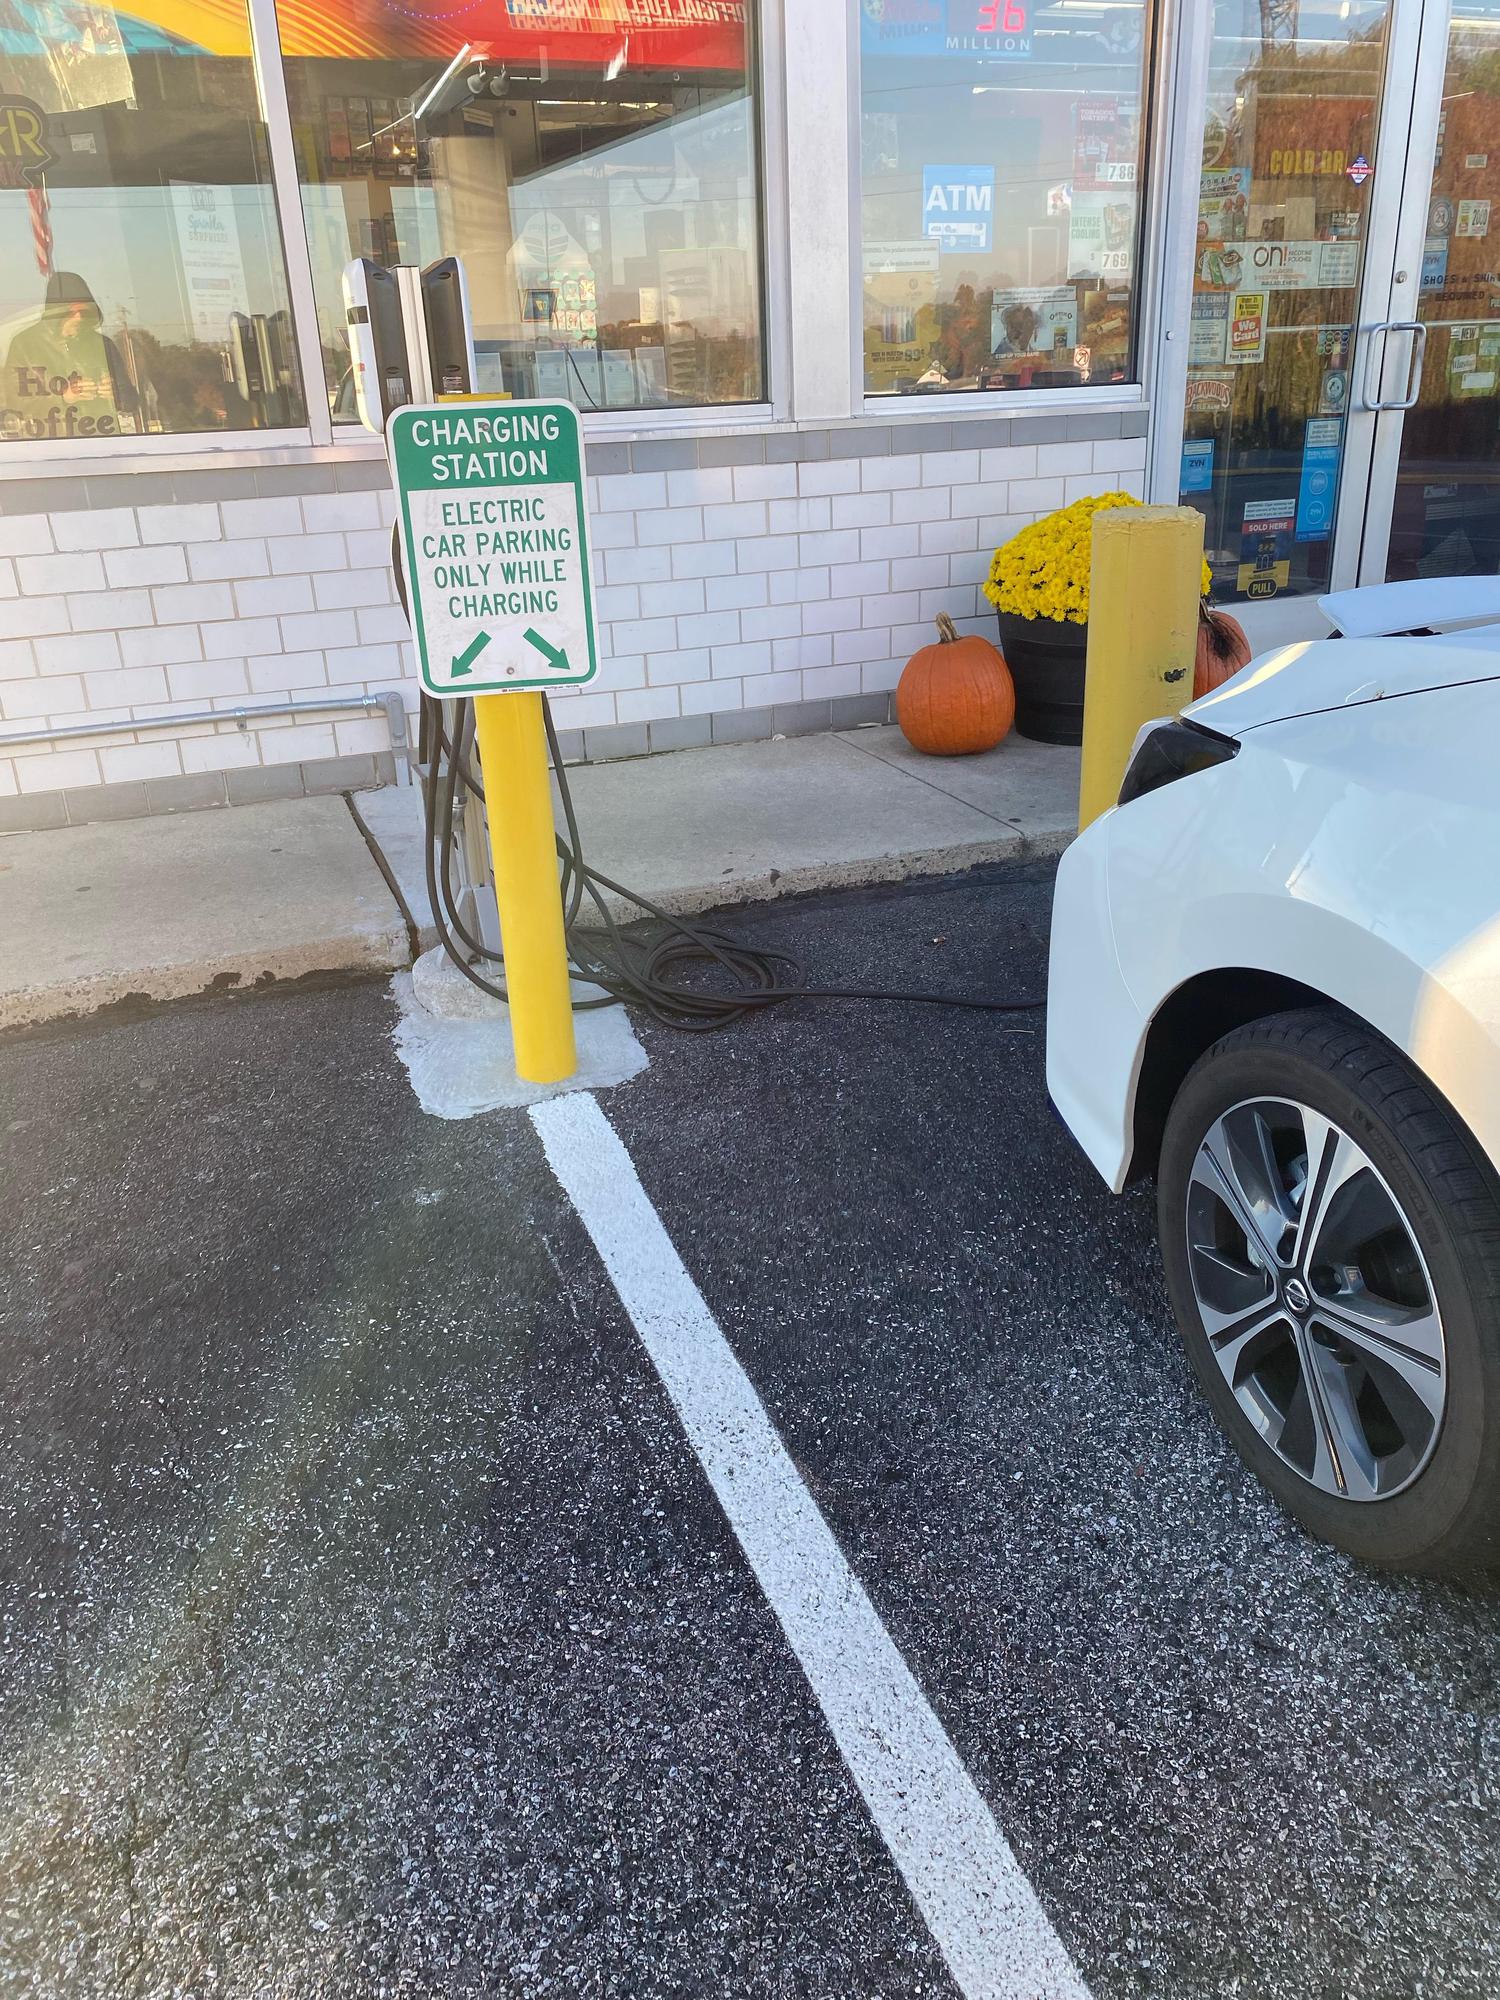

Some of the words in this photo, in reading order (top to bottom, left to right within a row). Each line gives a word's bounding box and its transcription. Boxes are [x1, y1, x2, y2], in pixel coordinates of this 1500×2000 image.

[946, 36, 1031, 52] MILLION
[1270, 149, 1316, 175] COLD
[926, 185, 991, 211] ATM
[1071, 229, 1101, 240] COOLING
[1423, 274, 1457, 285] SHOES
[1233, 328, 1260, 342] Card
[1238, 320, 1256, 332] We
[1461, 327, 1477, 340] NEW
[16, 366, 83, 397] Hot
[1185, 381, 1231, 409] BACKWOODS
[0, 406, 117, 438] Coffee
[411, 413, 561, 447] CHARGING
[431, 449, 548, 481] STATION
[1188, 459, 1205, 467] ZYN
[442, 498, 546, 527] ELECTRIC
[1248, 523, 1268, 532] SOLD
[1269, 522, 1288, 530] HERE
[422, 533, 466, 559] CAR
[476, 528, 572, 556] PARKING
[434, 563, 492, 589] ONLY
[500, 559, 567, 586] WHILE
[1252, 582, 1272, 594] PULL
[448, 590, 559, 619] CHARGING
